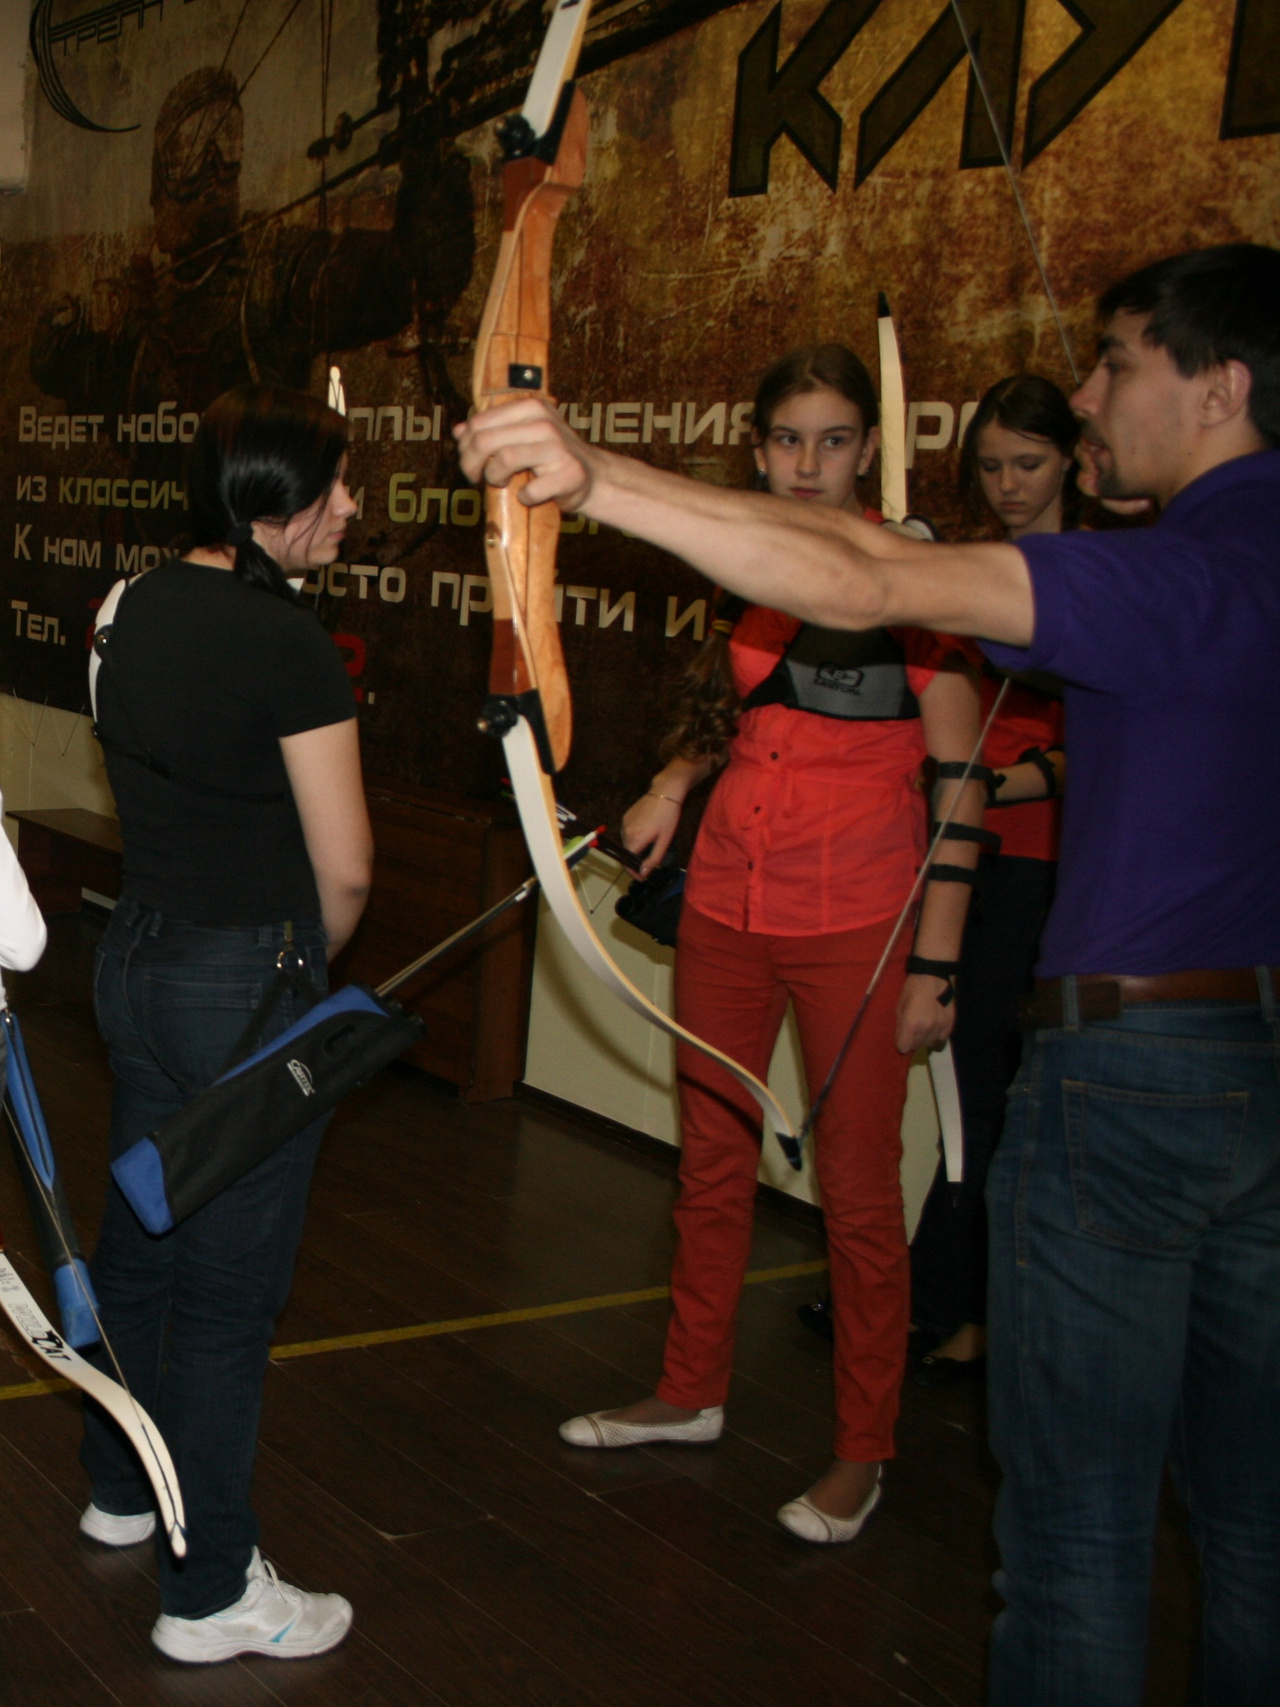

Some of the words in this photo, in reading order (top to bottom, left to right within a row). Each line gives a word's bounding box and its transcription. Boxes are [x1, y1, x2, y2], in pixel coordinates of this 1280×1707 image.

[728, 0, 1280, 198] КЛУ
[19, 406, 104, 450] Ведет
[117, 401, 206, 443] набо
[346, 404, 442, 442] ппы
[559, 402, 755, 446] чения
[16, 475, 47, 503] из
[58, 476, 189, 511] классич
[14, 523, 33, 561] К
[43, 536, 101, 569] нам
[302, 562, 407, 604] осто
[665, 595, 707, 641] и
[11, 600, 66, 646] Тел.
